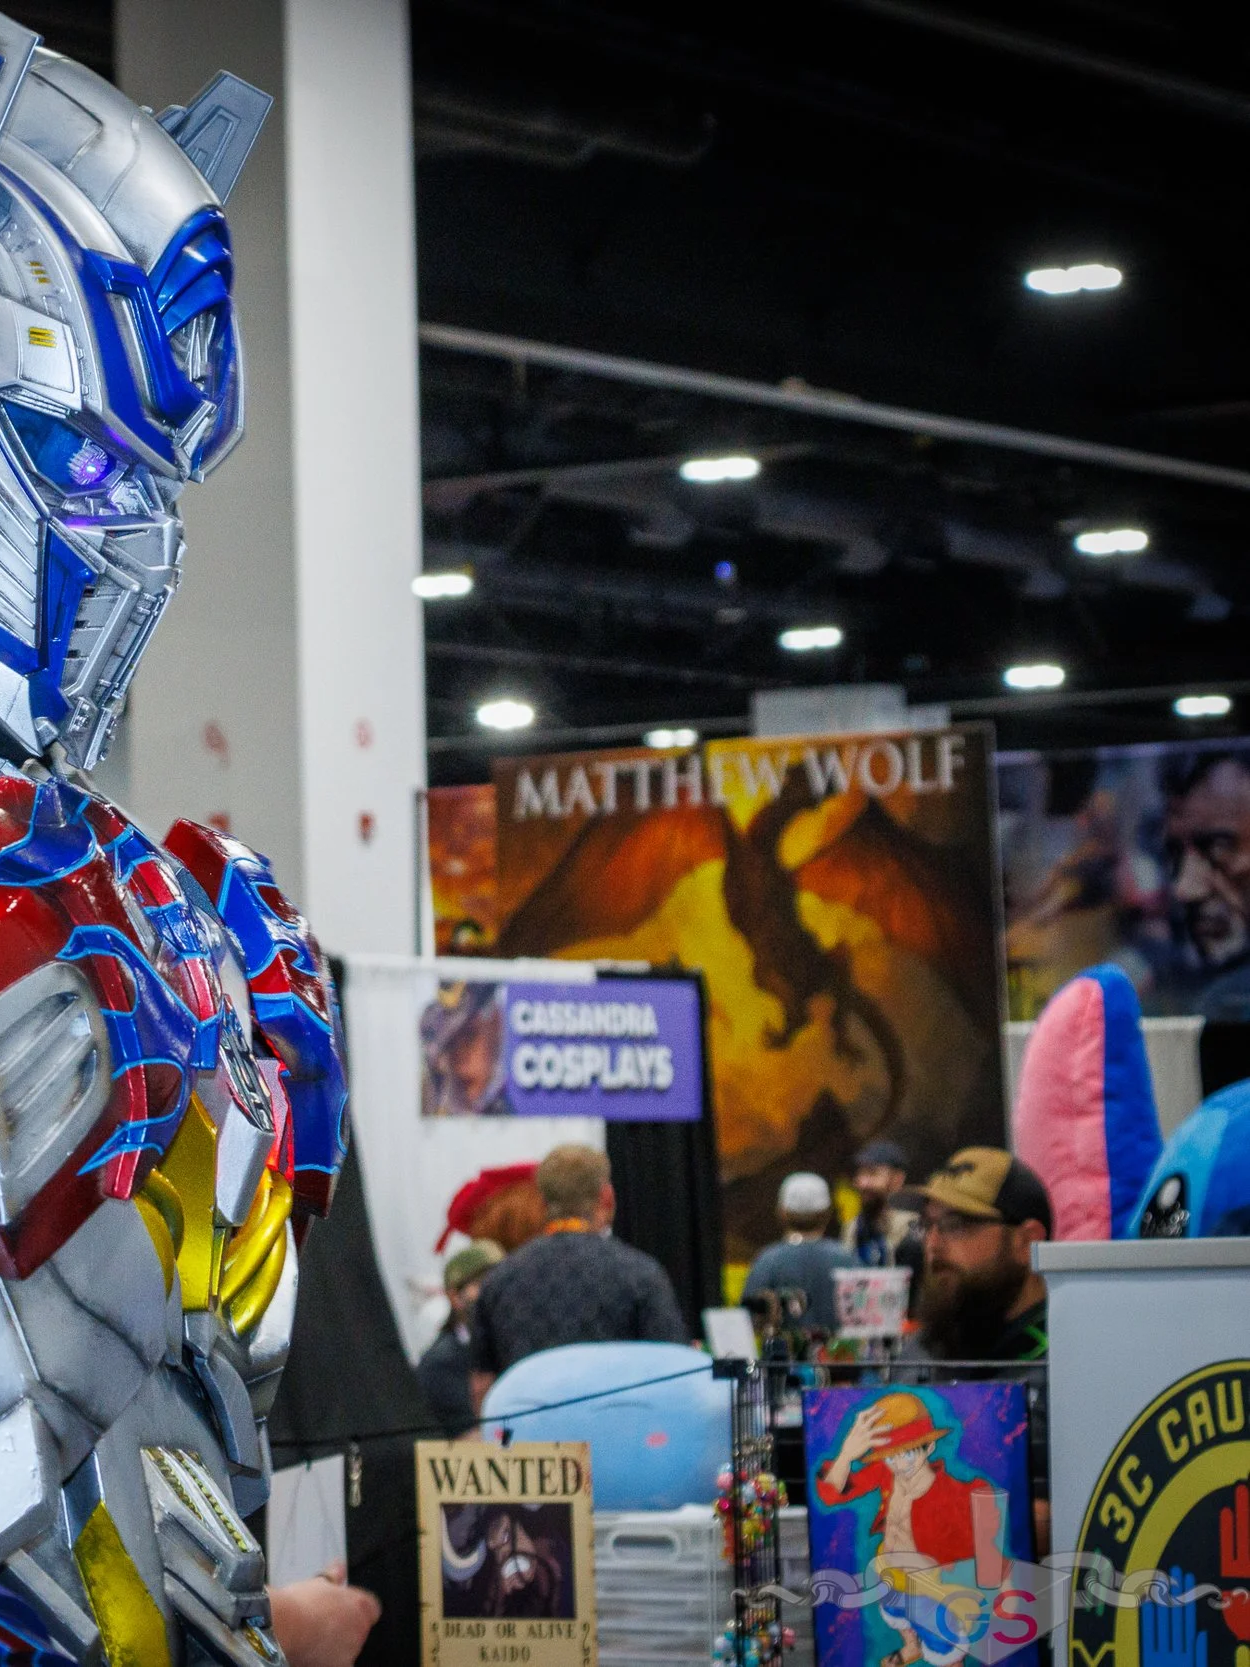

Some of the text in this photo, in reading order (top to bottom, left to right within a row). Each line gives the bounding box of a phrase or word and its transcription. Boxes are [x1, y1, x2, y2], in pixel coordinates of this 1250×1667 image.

[514, 735, 966, 820] MATTHEW WOLF
[511, 1001, 658, 1038] CASSANDRA
[512, 1043, 674, 1090] COSPLAYS
[428, 1455, 584, 1497] WANTED
[1099, 1453, 1154, 1544] 3C
[444, 1622, 577, 1640] DEAD OR ALIVE
[478, 1645, 532, 1663] KAIDO
